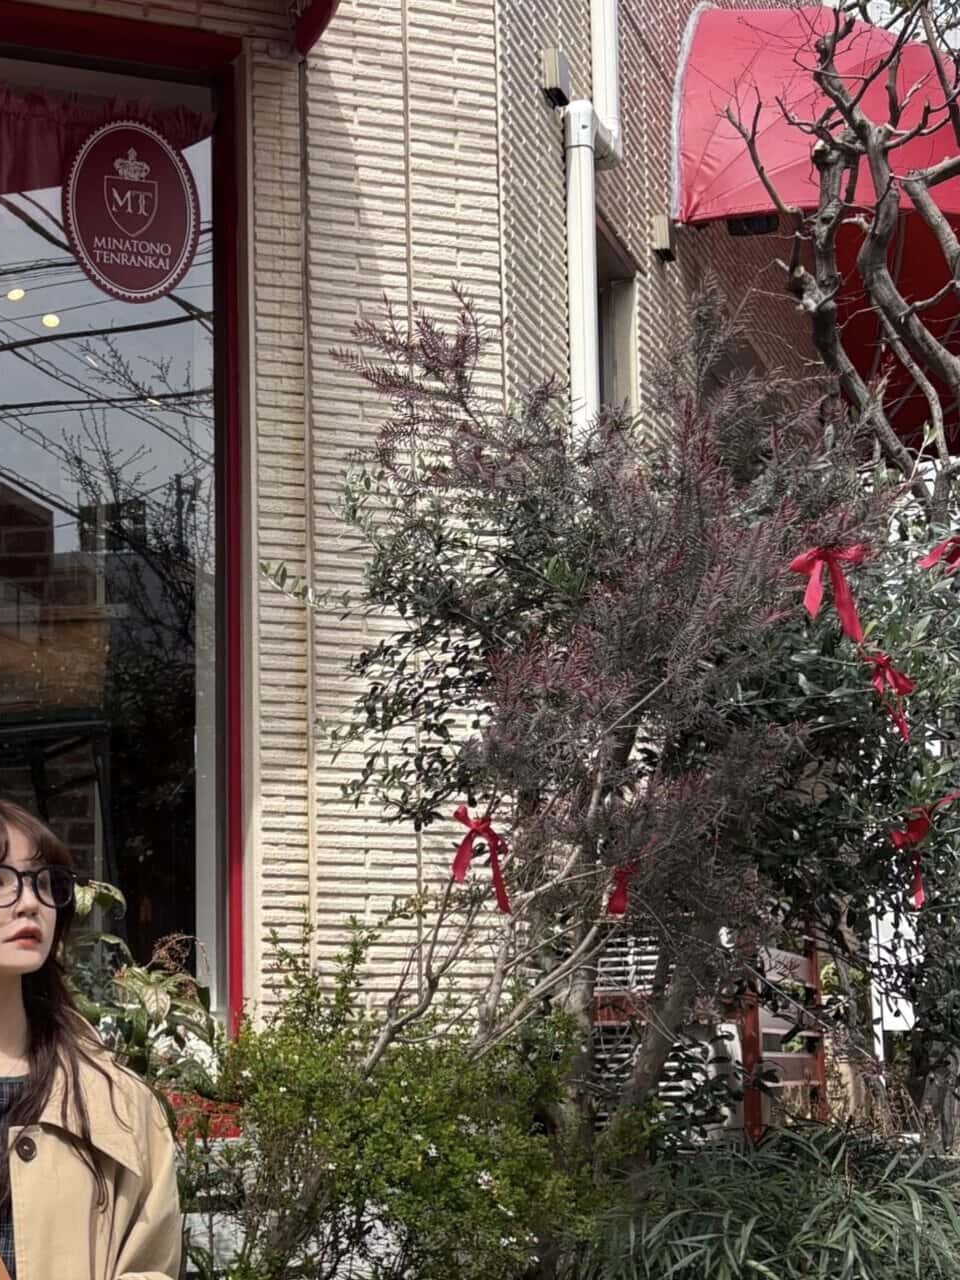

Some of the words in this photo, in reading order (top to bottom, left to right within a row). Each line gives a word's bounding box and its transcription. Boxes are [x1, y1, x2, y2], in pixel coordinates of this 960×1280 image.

[112, 187, 153, 216] MT
[93, 236, 171, 256] MINATONO
[93, 249, 170, 271] TENRANKAI
